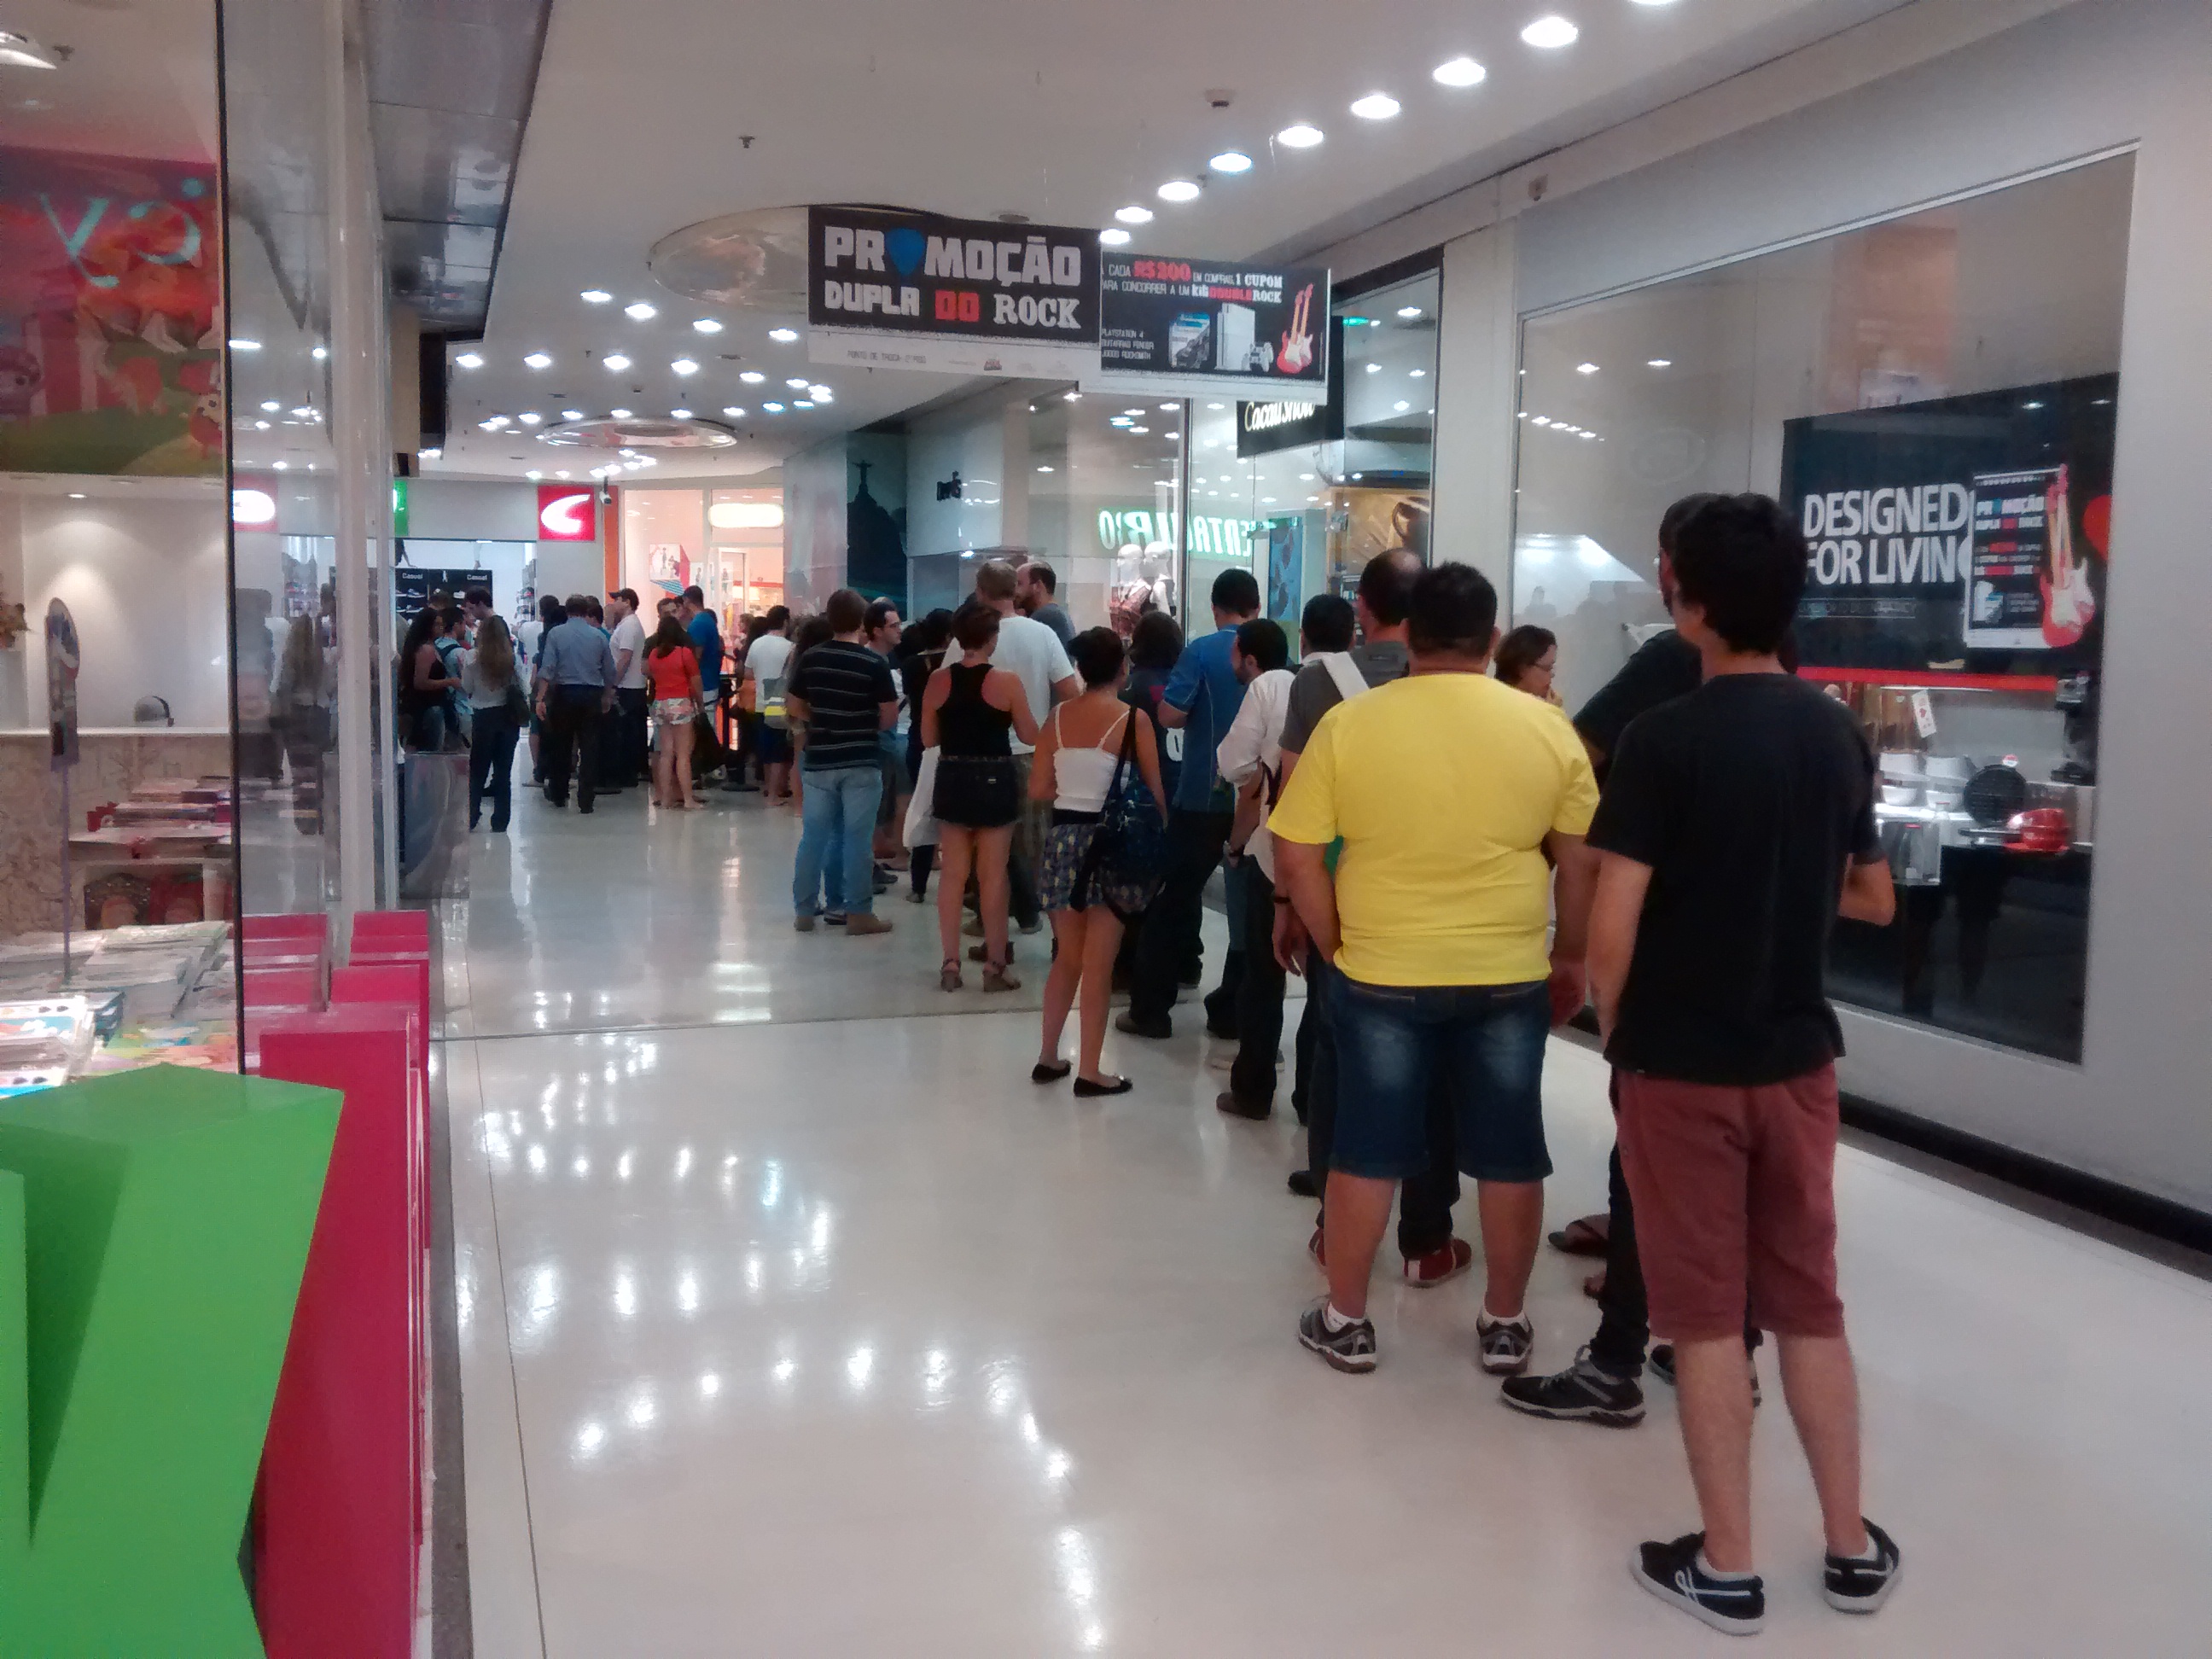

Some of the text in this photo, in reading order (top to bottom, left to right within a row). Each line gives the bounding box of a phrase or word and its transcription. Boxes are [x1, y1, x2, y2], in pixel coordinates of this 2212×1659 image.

[1109, 264, 1132, 277] CADA
[824, 280, 1082, 329] DUPLA DO ROCK
[1803, 483, 1968, 538] DESIGNED
